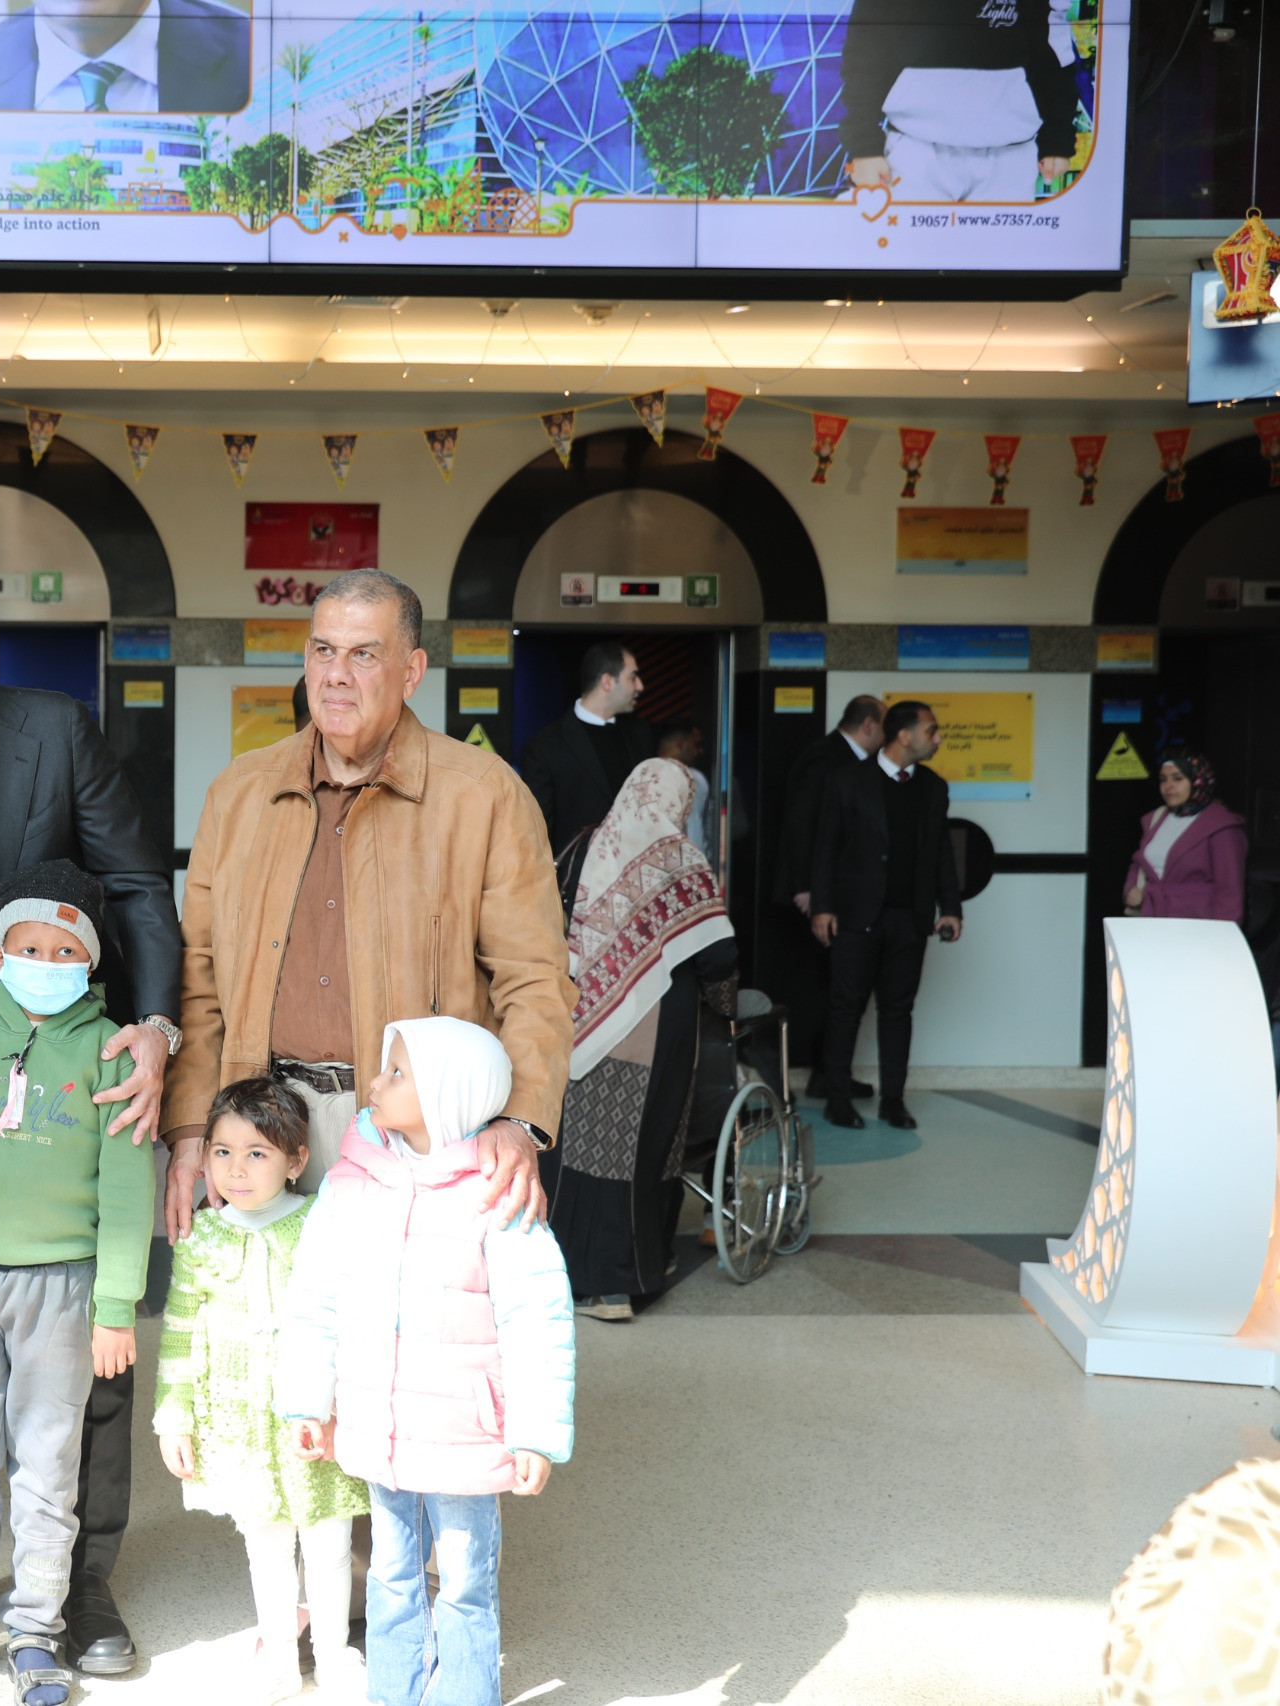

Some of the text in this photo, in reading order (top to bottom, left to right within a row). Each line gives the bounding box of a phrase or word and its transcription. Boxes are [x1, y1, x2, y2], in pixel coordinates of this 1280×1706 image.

[23, 217, 52, 231] into
[56, 217, 101, 231] action
[910, 214, 949, 227] 19057
[957, 214, 1060, 229] www.57357.org
[5, 1131, 32, 1142] STREET
[36, 1135, 53, 1146] NICE
